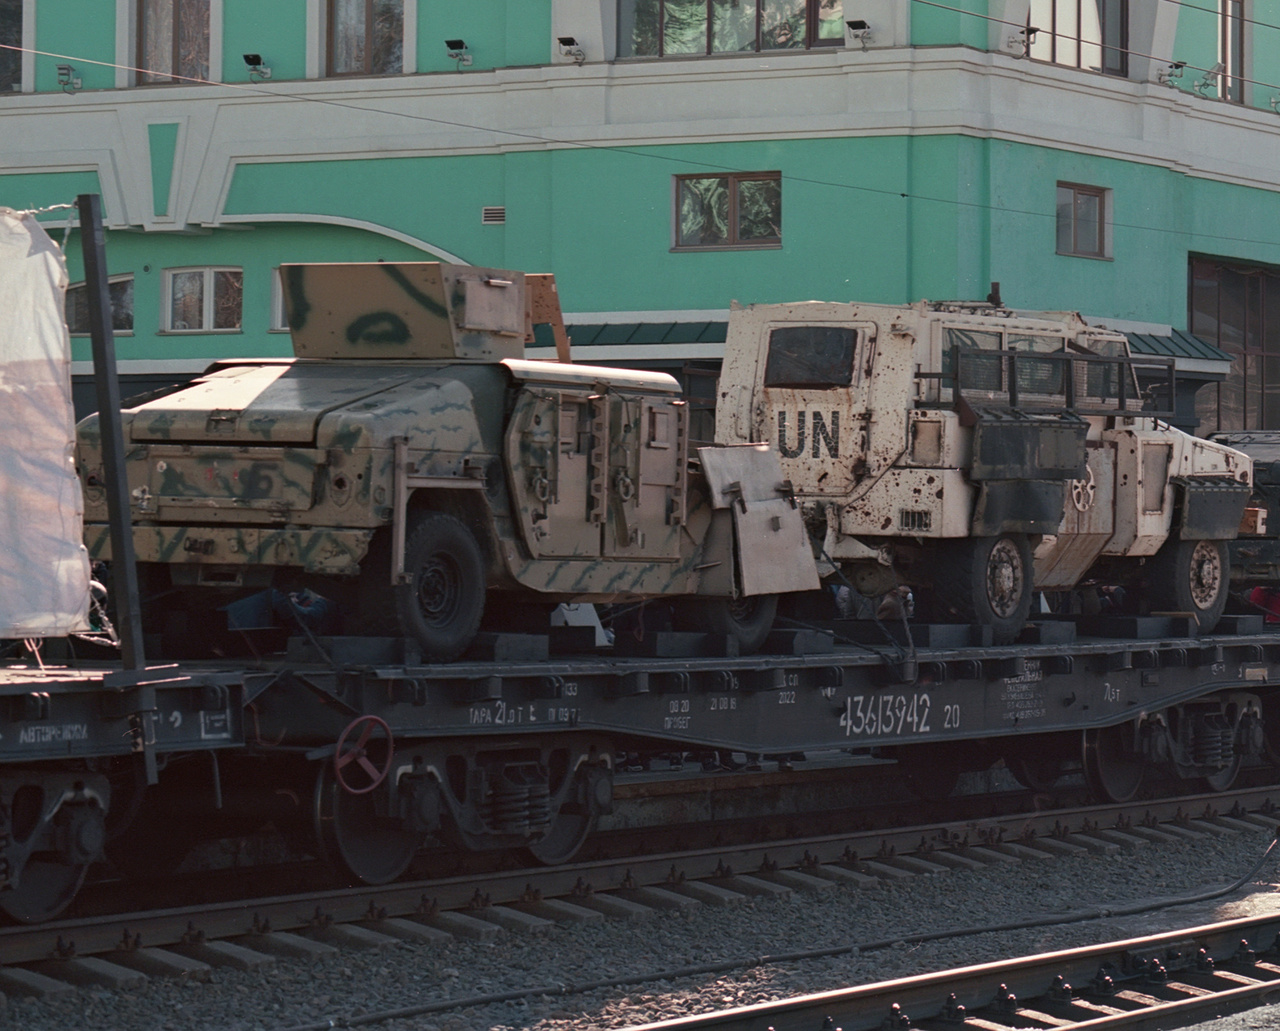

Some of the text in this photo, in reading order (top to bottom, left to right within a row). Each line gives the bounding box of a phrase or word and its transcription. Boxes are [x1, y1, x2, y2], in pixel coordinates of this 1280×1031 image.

[778, 410, 840, 459] UN
[838, 692, 961, 737] 43613942 20
